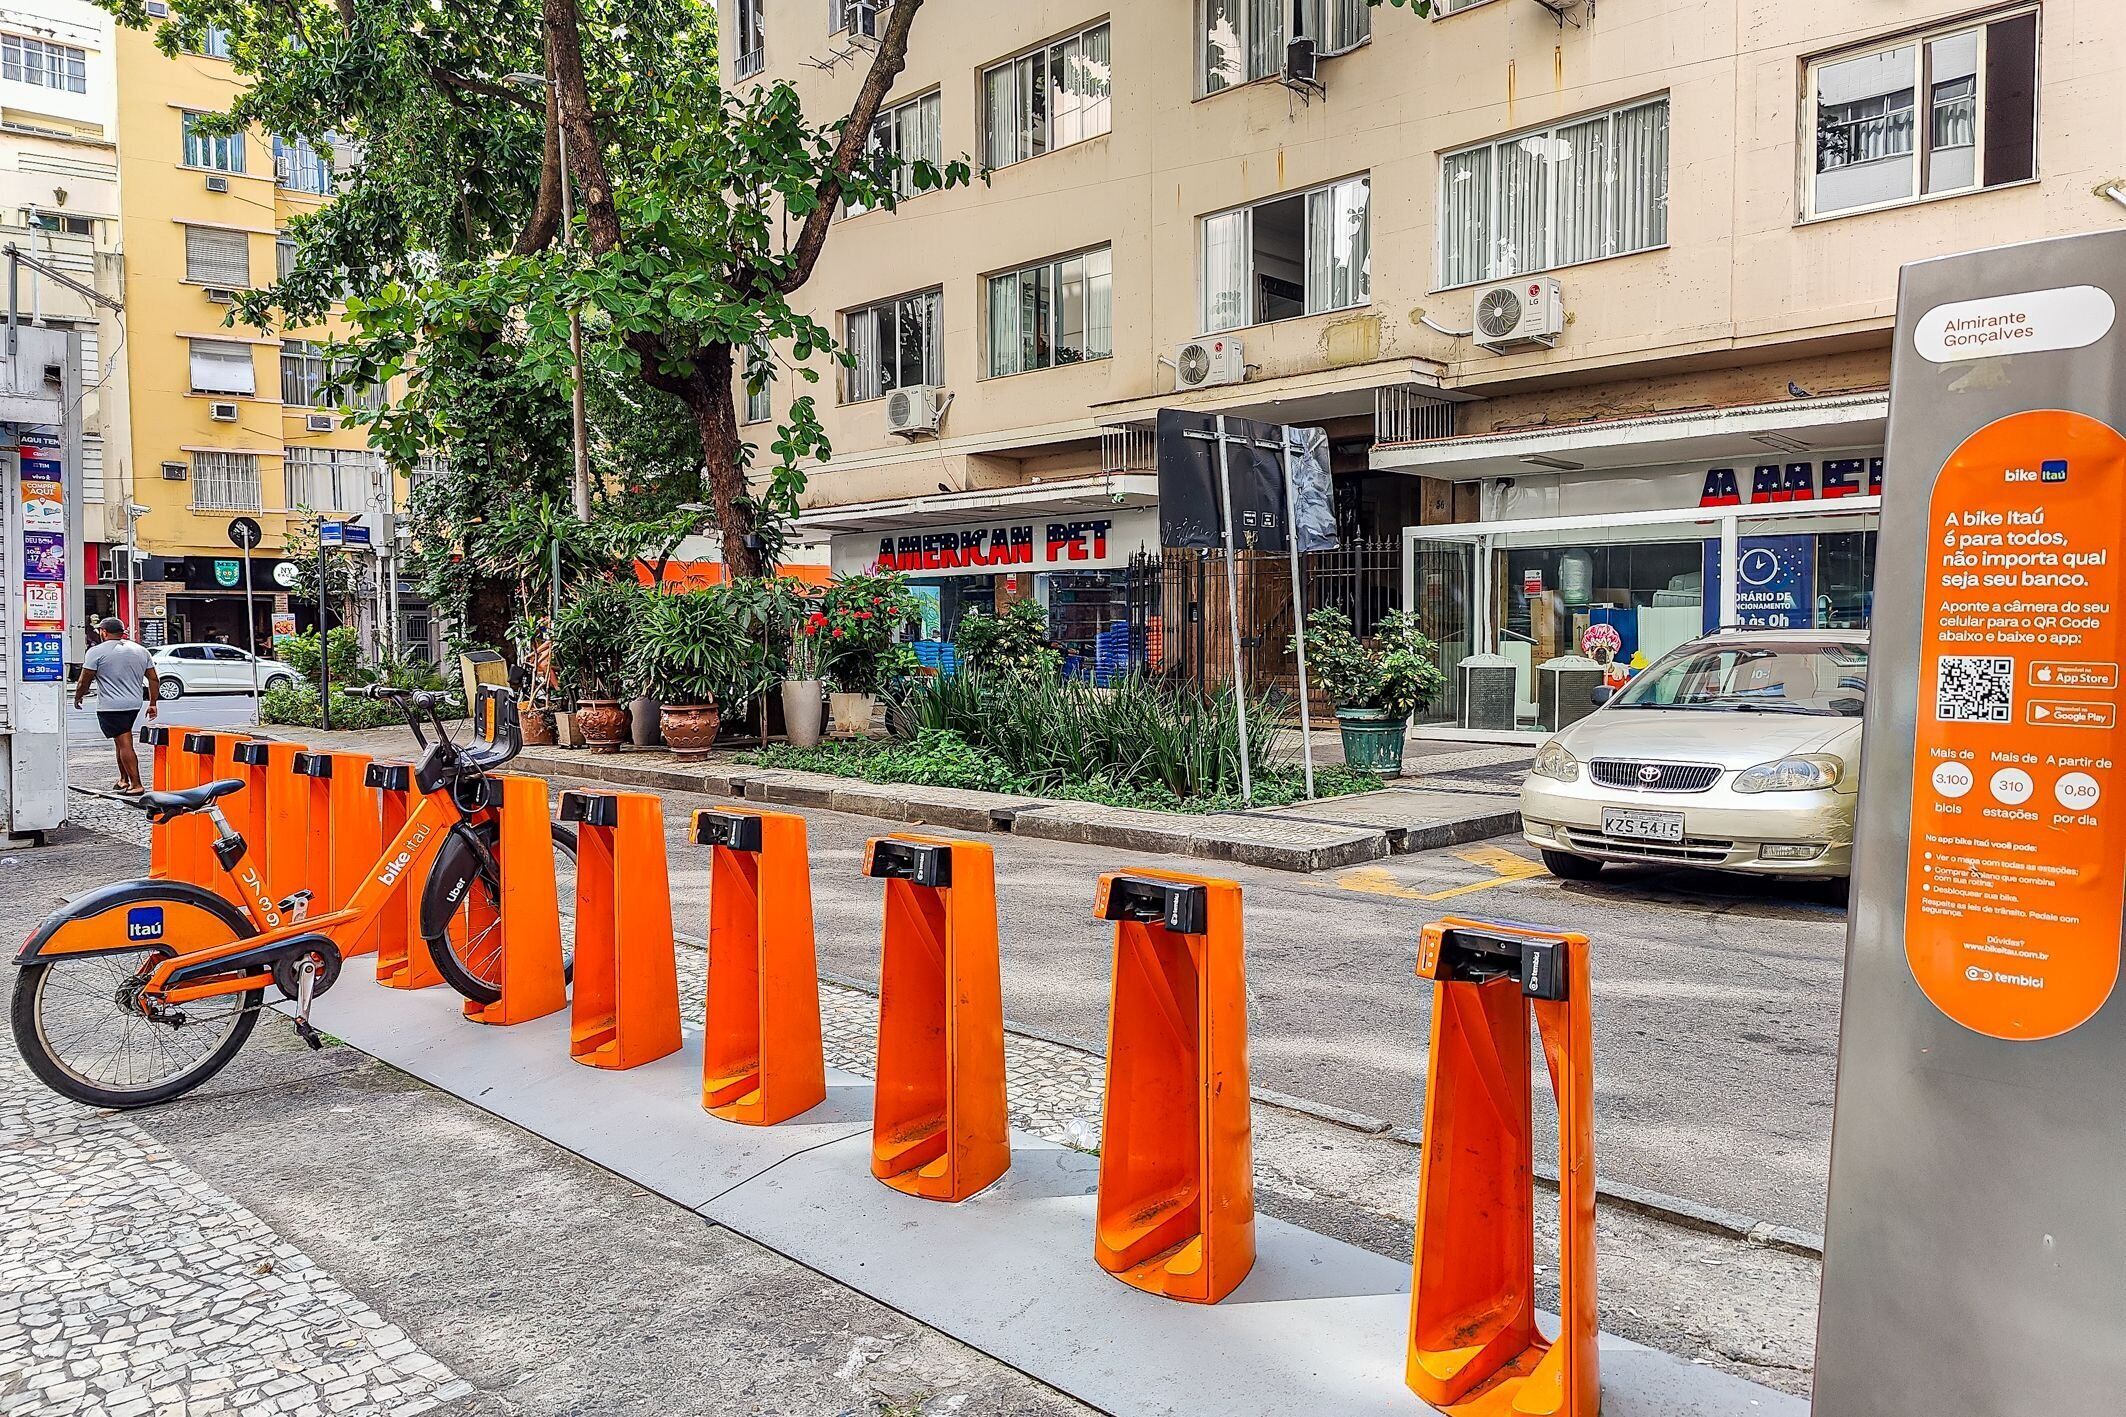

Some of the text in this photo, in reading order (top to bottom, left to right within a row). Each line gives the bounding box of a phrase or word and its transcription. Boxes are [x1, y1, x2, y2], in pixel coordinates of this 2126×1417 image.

[1944, 312, 2026, 333] Almirante
[1944, 327, 2034, 347] Gonçalves
[21, 436, 41, 444] AQUI
[2005, 469, 2066, 482] bike Itaú
[1945, 506, 2044, 527] A bike Itaú
[876, 525, 1033, 572] AMERICAN
[1046, 519, 1112, 562] PET
[1944, 529, 2068, 549] é para todos,
[1943, 549, 2107, 569] não importa qual
[1941, 571, 2089, 589] seja seu banco.
[1736, 591, 1791, 601] ORÁRIO DE
[1939, 600, 2110, 615] Aponte a câmera do seu
[1939, 615, 2100, 629] celular para o QR Code
[1938, 631, 2082, 646] abaixo e baixe o app:
[2056, 673, 2109, 684] App Store
[2054, 711, 2106, 723] Google Play
[1930, 748, 1975, 760] Mais de
[1991, 752, 2038, 764] Mais de
[2046, 754, 2112, 769] A partir de
[1936, 774, 1969, 786] 3.100
[1999, 780, 2024, 792] 310
[2064, 784, 2097, 797] 0,80
[1983, 807, 2039, 821] estações
[2053, 814, 2097, 826] por dia
[1605, 818, 1634, 833] KZS
[1925, 834, 1937, 842] No
[1938, 837, 1953, 845] app
[1954, 837, 1973, 845] bike
[1991, 841, 2012, 850] você
[377, 822, 431, 887] bike itaú
[1936, 853, 1950, 861] Ver
[1981, 859, 2000, 867] com
[1935, 867, 1969, 876] Comprar
[446, 877, 466, 902] Uber
[1933, 886, 1983, 897] Desbloquear
[1922, 897, 1956, 908] Respeite
[130, 922, 161, 936] Itaú
[1987, 936, 2025, 947] Dúvidas?
[1532, 951, 1540, 977] tembici
[1995, 972, 2044, 988] tembici
